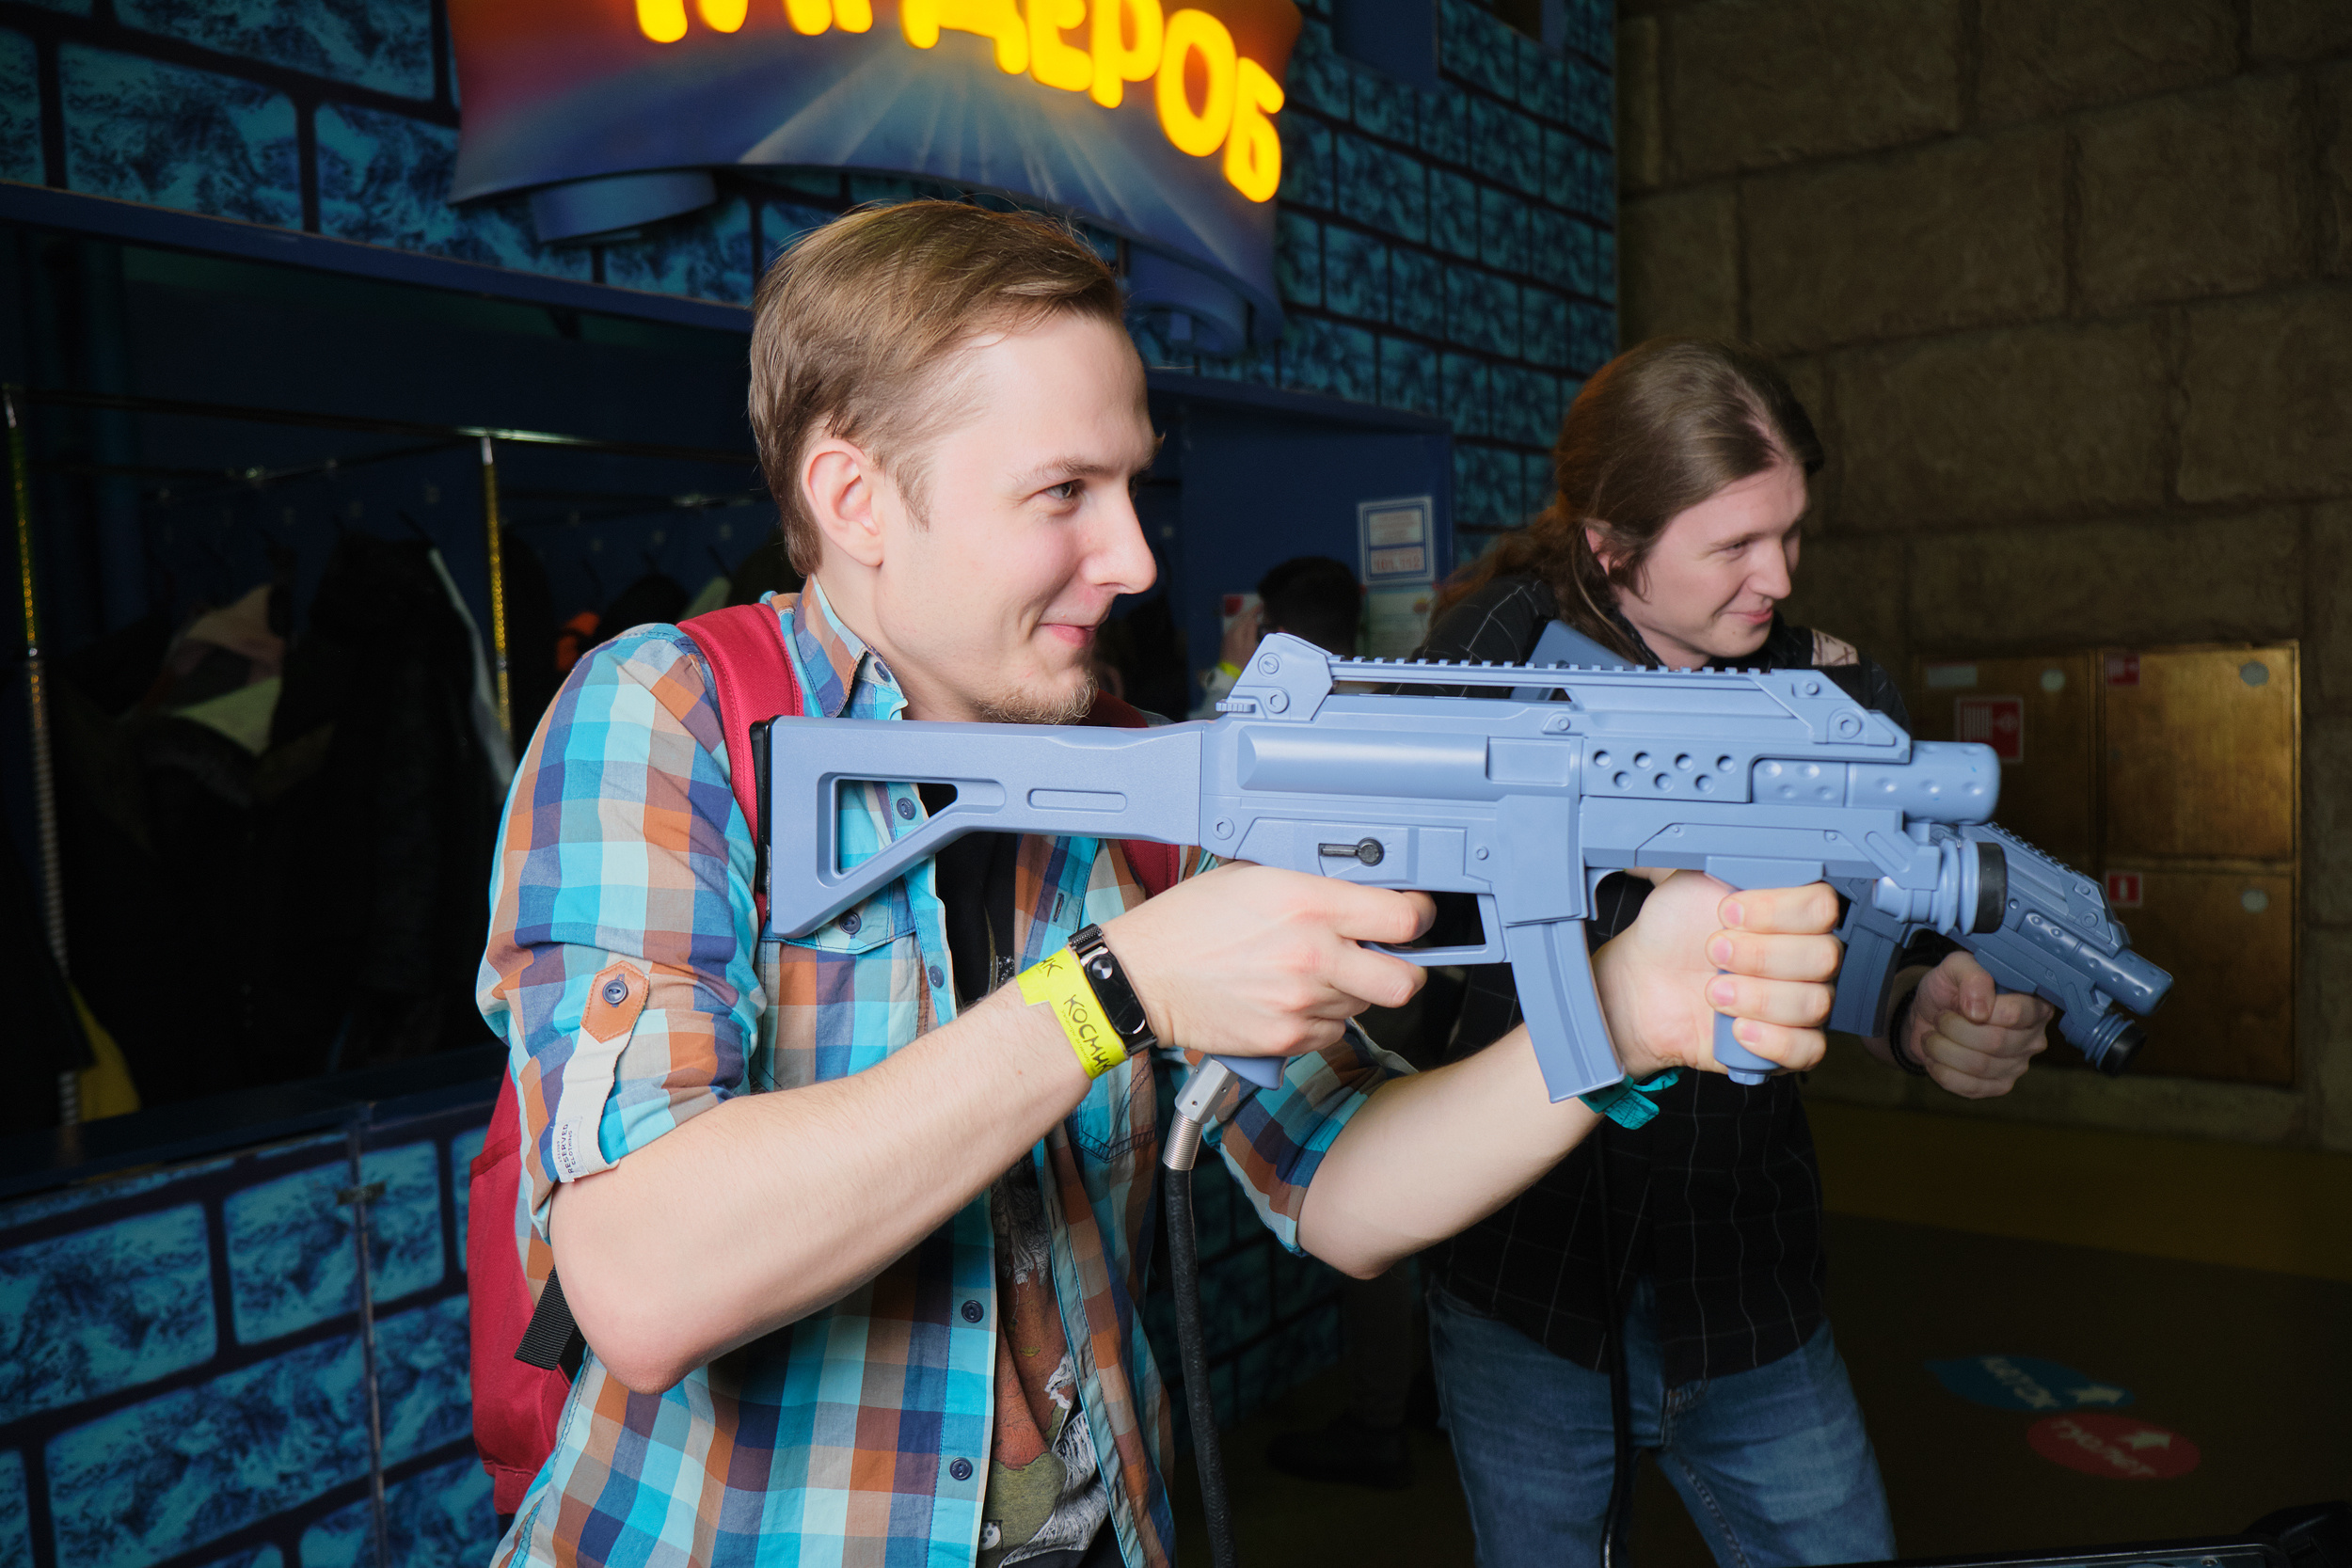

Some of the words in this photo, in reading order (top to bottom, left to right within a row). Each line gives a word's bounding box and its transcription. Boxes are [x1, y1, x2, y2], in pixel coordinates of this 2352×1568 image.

[636, 0, 1285, 203] ЕРОБ
[1063, 993, 1116, 1075] КОСМИК
[562, 1124, 574, 1175] RESERVED
